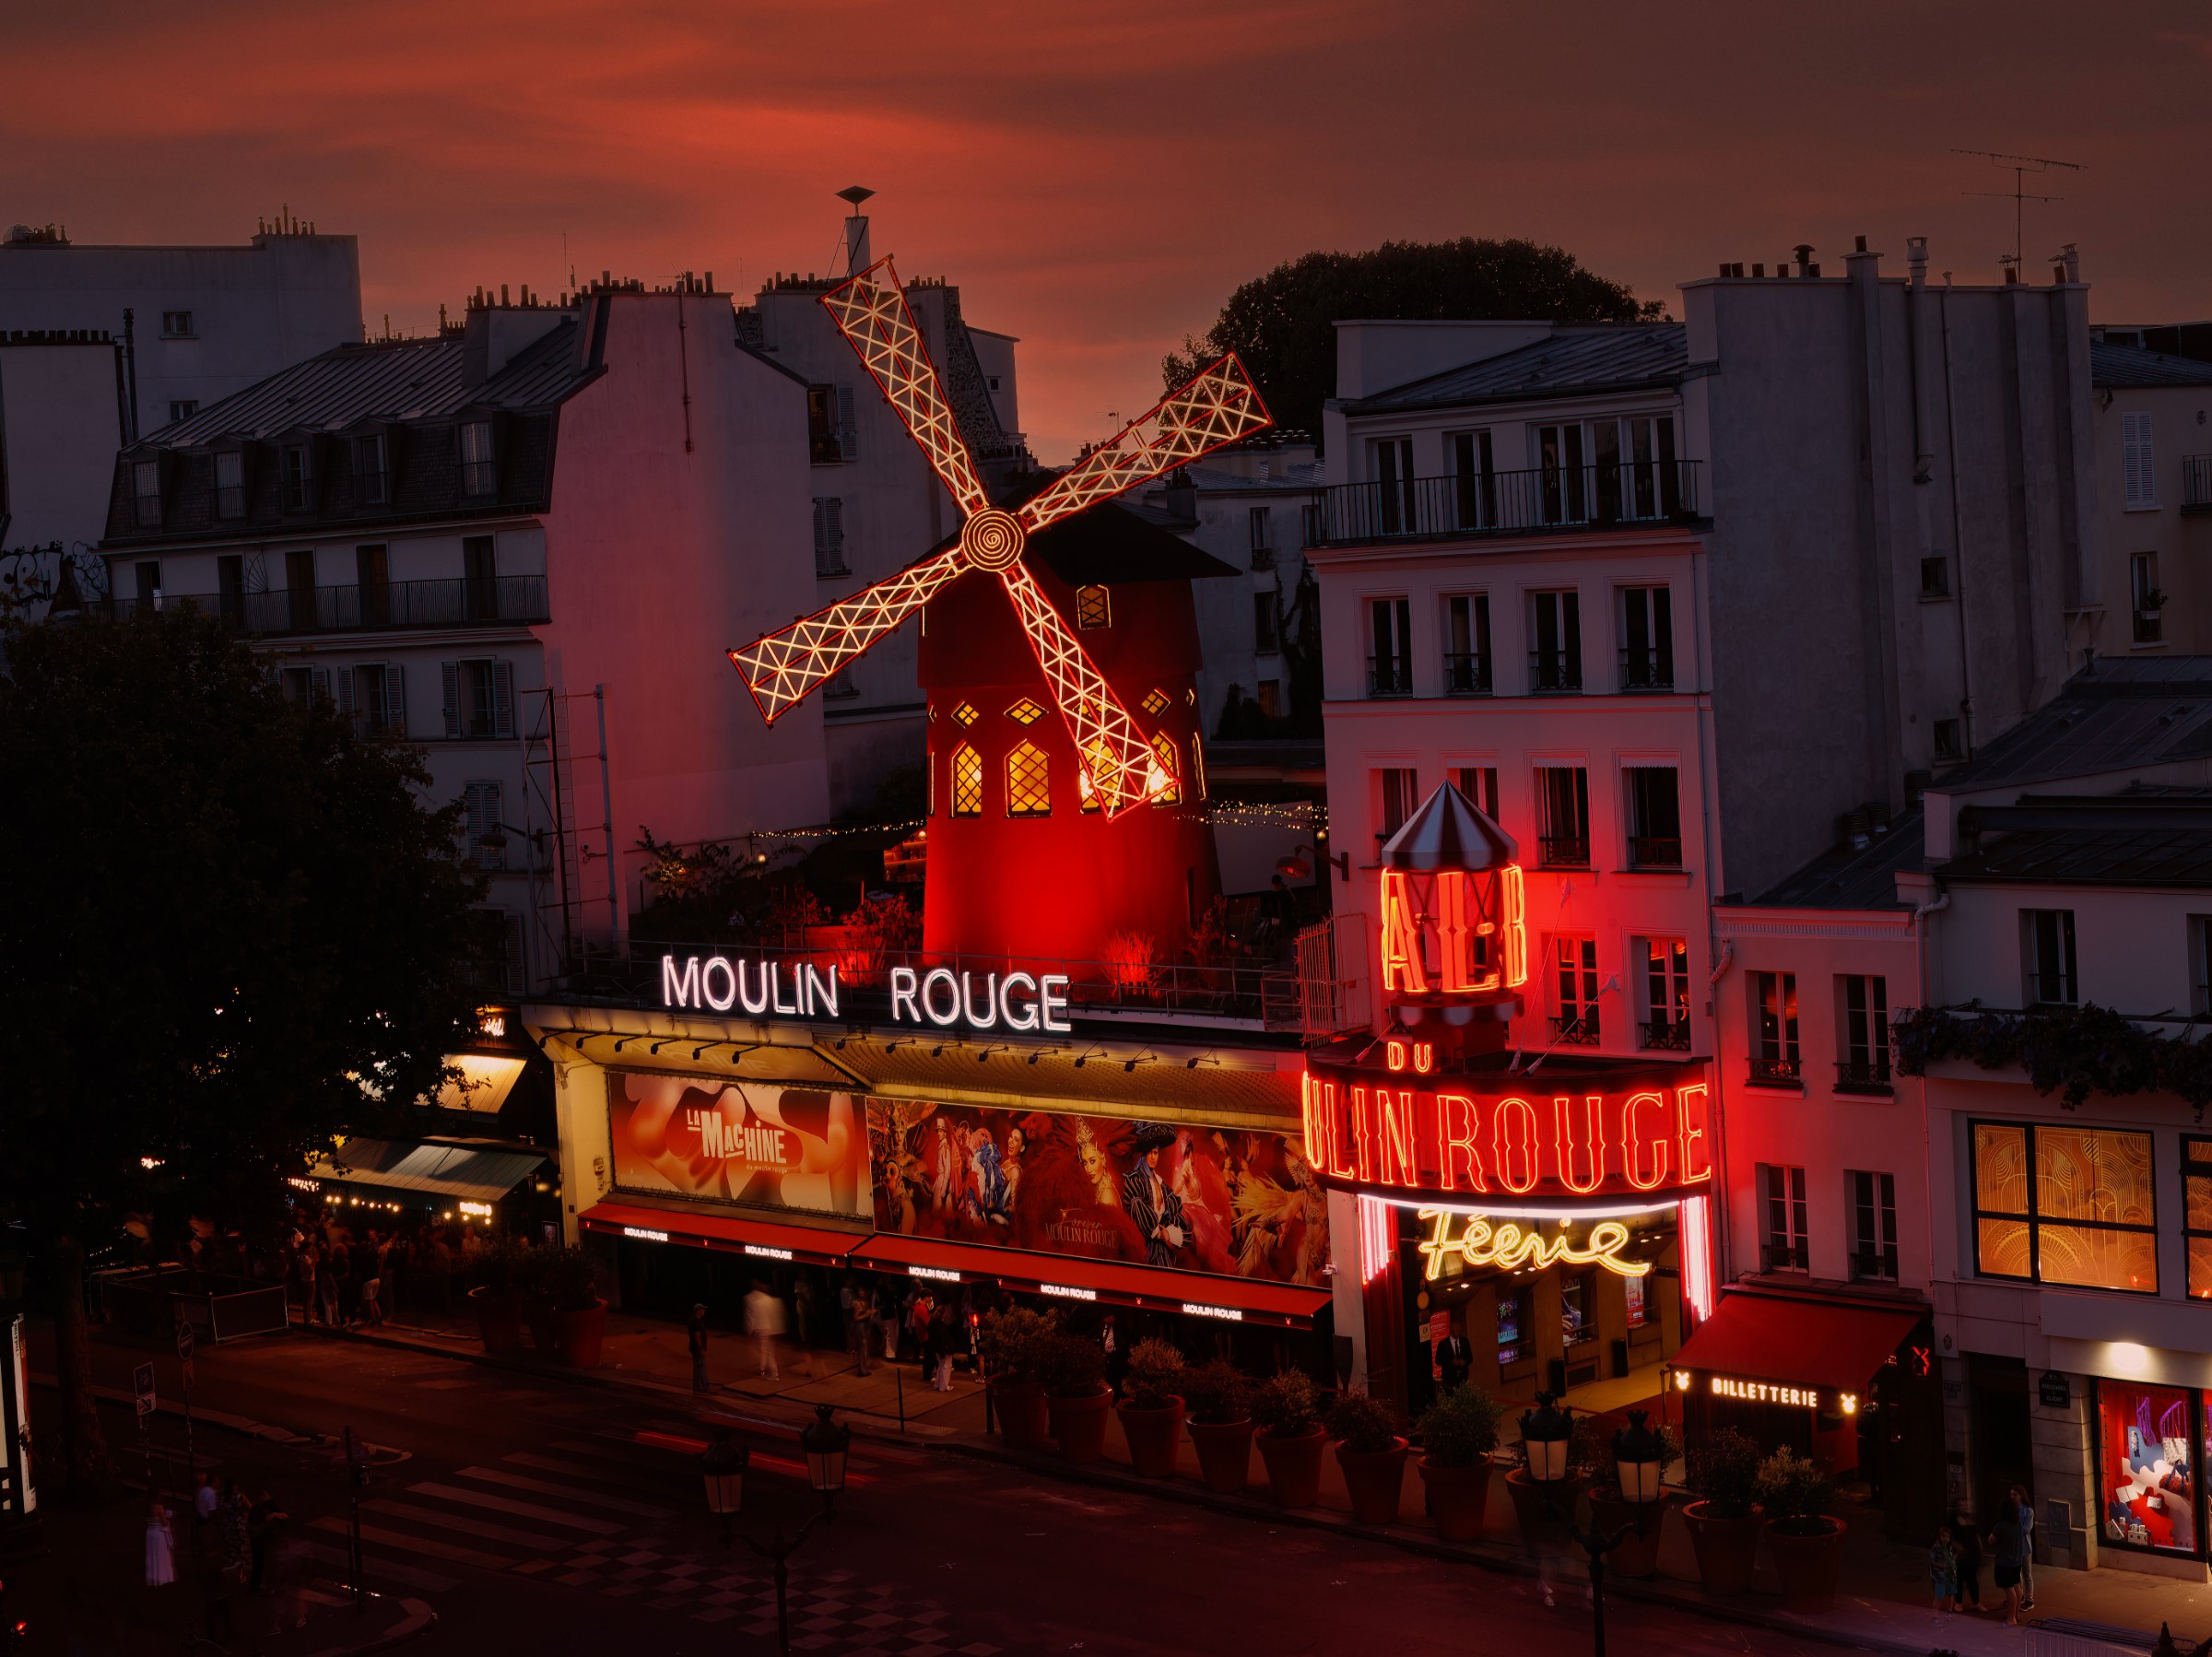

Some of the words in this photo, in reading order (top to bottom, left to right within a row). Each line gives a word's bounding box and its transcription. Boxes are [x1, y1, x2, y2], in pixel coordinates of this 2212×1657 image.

[663, 955, 839, 1017] MOULIN
[890, 967, 1072, 1032] ROUGE
[1387, 1041, 1430, 1073] DU
[687, 1109, 700, 1126] LA
[700, 1111, 787, 1164] MACHINE
[1436, 1083, 1712, 1193] ROUGE
[1044, 1222, 1082, 1243] MOULIN
[1083, 1228, 1120, 1250] ROUGE
[1712, 1378, 1818, 1407] BILLETTERIE
